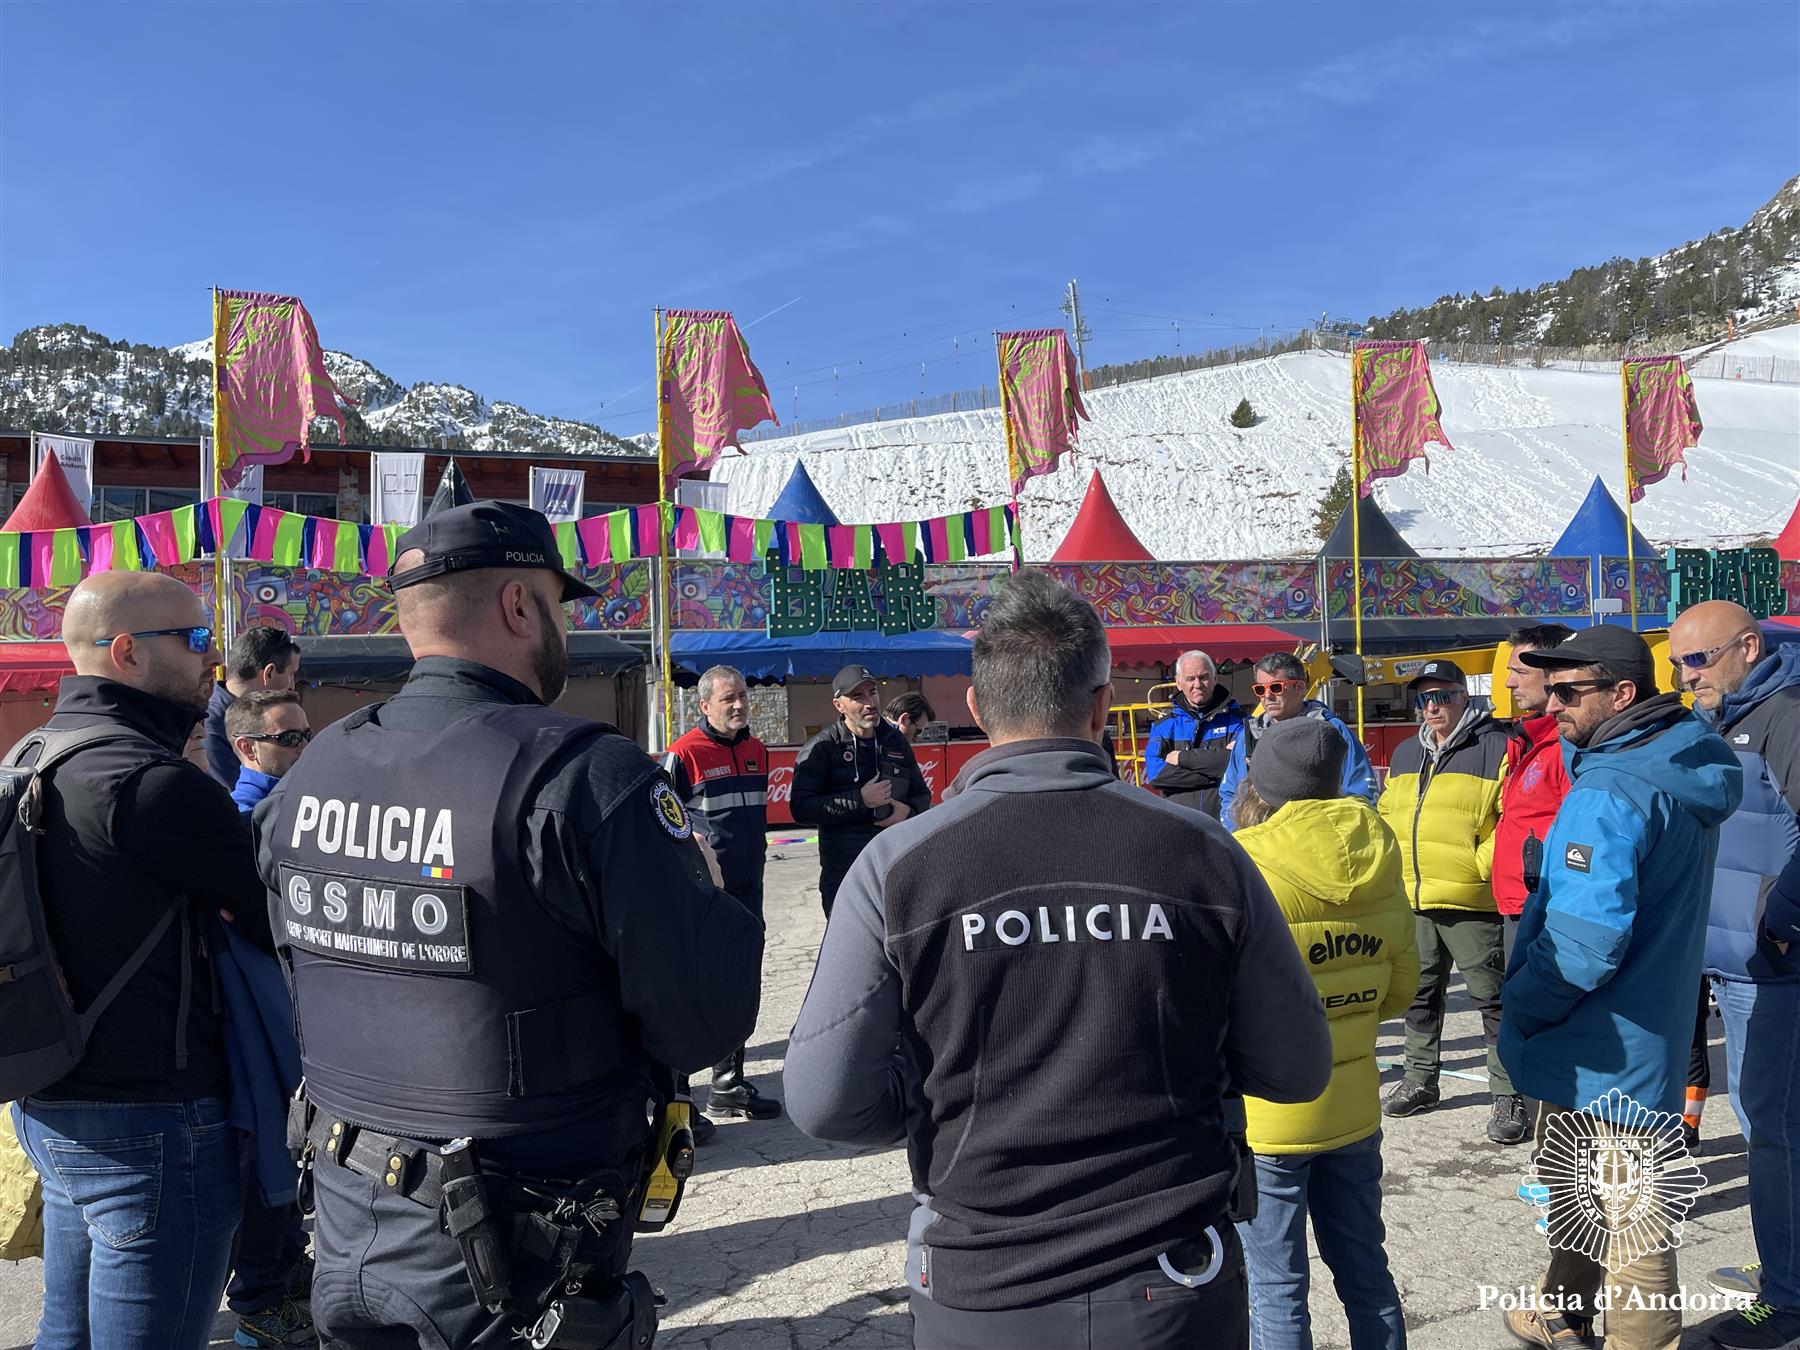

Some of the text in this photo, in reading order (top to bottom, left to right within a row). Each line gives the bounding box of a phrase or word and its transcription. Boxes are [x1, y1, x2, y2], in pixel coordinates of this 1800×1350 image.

[505, 551, 545, 563] POLICIA
[763, 547, 937, 640] BAR
[1666, 547, 1788, 623] BAR
[291, 795, 454, 866] POLICIA
[303, 925, 332, 948] SUPORT
[334, 931, 399, 959] MANTENIMENT
[401, 942, 416, 960] DE
[418, 943, 468, 963] L'ORDRE
[961, 903, 1174, 951] POLICIA
[1308, 930, 1383, 965] elrow
[1321, 989, 1377, 1009] EAD
